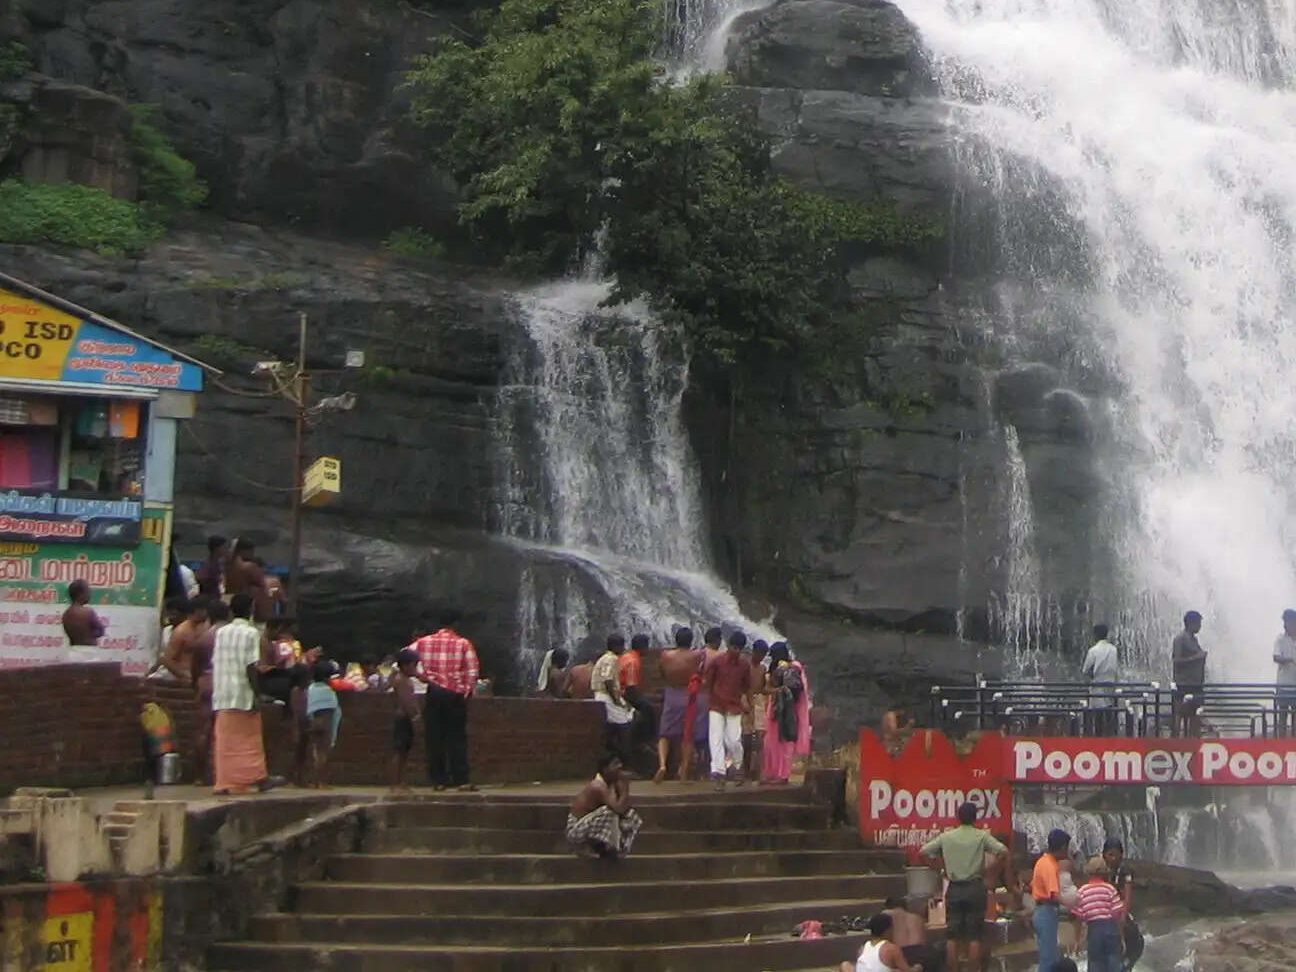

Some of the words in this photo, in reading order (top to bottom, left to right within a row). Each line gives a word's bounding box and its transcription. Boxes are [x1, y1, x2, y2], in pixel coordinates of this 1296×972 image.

[24, 321, 74, 341] ISD
[41, 552, 136, 587] மாற்றும்
[1014, 741, 1193, 781] Poomex
[869, 779, 1002, 820] Poomex
